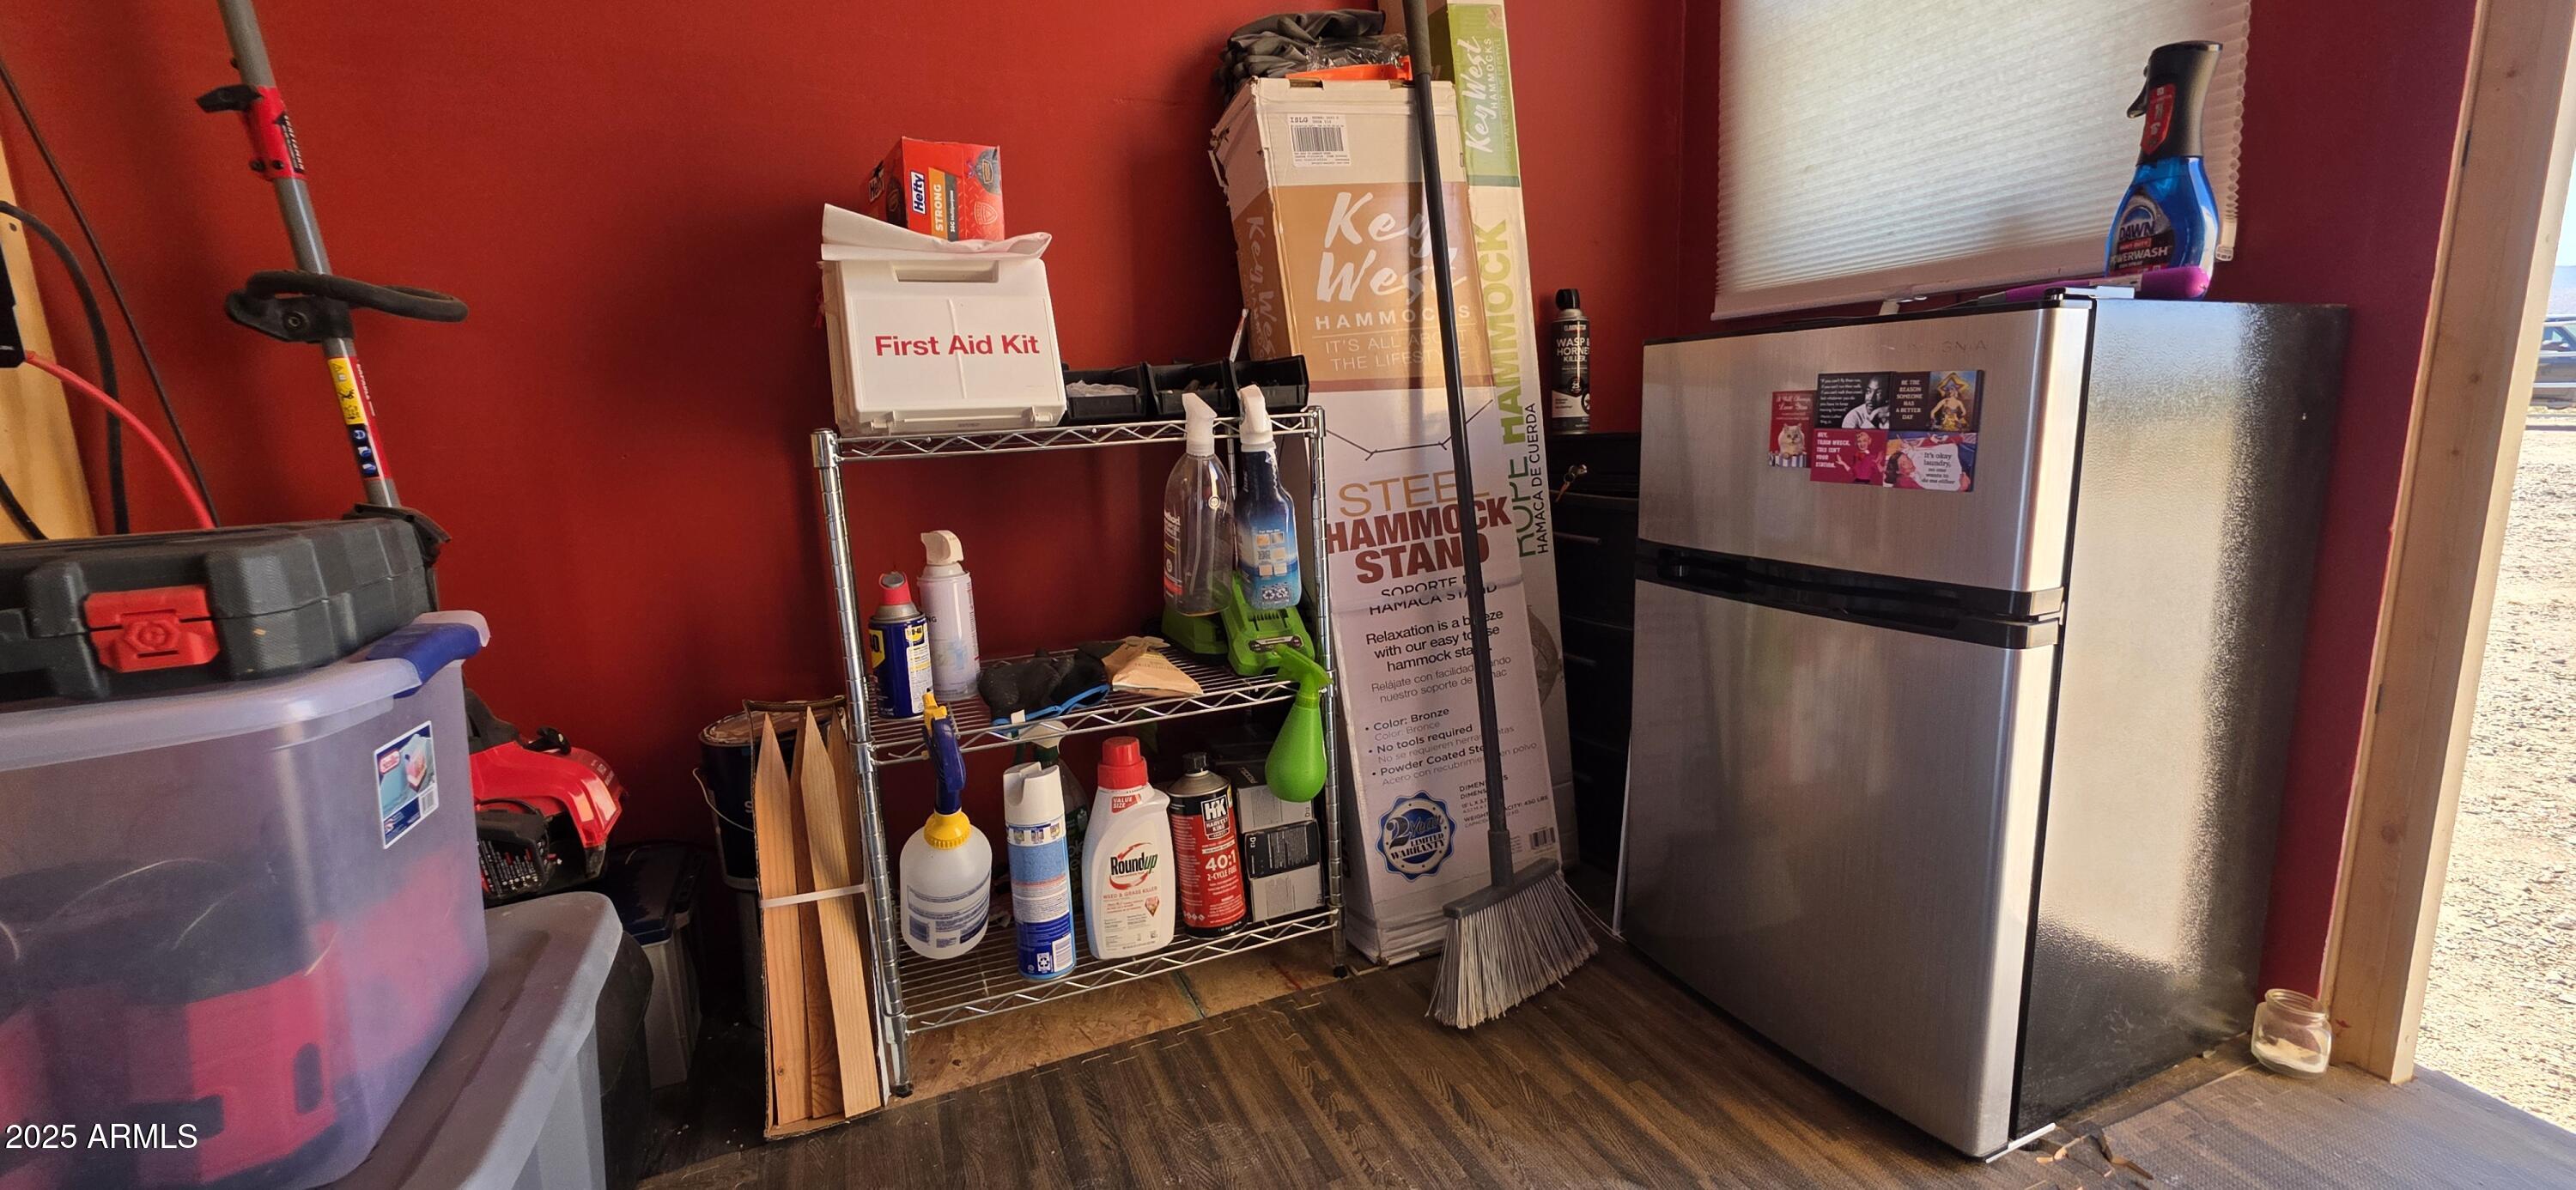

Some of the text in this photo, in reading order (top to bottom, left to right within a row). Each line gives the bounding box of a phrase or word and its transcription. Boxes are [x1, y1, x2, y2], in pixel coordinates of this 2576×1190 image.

[1484, 37, 1499, 110] HAMMOCKS
[1456, 35, 1498, 153] Key West
[913, 173, 926, 213] Hefty
[934, 182, 944, 232] STRONG
[1324, 191, 1431, 258] Key
[2119, 221, 2155, 240] DAWN
[1246, 216, 1278, 361] Key Wes
[1315, 305, 1471, 331] HAMMOCS
[1325, 329, 1467, 354] IT'S ALL ABOT
[1477, 219, 1527, 445] HAMMOCK
[1556, 337, 1585, 348] WASP
[875, 334, 1040, 356] First Aid Kit
[1556, 347, 1589, 356] HORNE
[1330, 347, 1467, 372] THE LIFESTE
[1923, 459, 1952, 468] laundry,
[1935, 452, 1953, 461] okay
[1525, 403, 1549, 554] HAMACA DE CUERDA
[1327, 496, 1512, 554] HAMMOCK
[1355, 532, 1490, 584] STAND
[1381, 576, 1457, 597] SOPORTE
[1370, 585, 1498, 616] HAMACA STD
[1366, 610, 1504, 645] Relaxation is a beze
[1374, 644, 1402, 659] with
[1406, 641, 1427, 653] our
[1431, 634, 1459, 649] easy
[1462, 630, 1473, 641] to
[1388, 645, 1492, 672] hammock sta.
[1371, 677, 1412, 693] Relájate
[1413, 673, 1433, 683] con
[1435, 664, 1474, 679] facilidad
[1380, 675, 1473, 703] nuestro soporte de
[1374, 707, 1449, 732] Color: Bronze
[1375, 721, 1441, 742] Color: Bronce
[1377, 724, 1473, 754] No tools required
[1378, 726, 1516, 765] No se requieren herratas
[1380, 744, 1485, 775] Powder Coated Ste
[1382, 774, 1411, 786] Acero
[1413, 768, 1431, 780] con
[1433, 757, 1485, 775] recubrimie
[1513, 741, 1538, 755] polvo
[1459, 774, 1510, 792] DIMENS
[1205, 798, 1227, 820] HK
[1464, 811, 1489, 823] WEIGHT
[1206, 817, 1229, 829] HARVEST
[1212, 823, 1225, 833] KING
[1386, 813, 1445, 849] 2 Year
[1390, 840, 1446, 861] WARRANTY
[1410, 832, 1445, 848] LIMITED
[1110, 852, 1158, 876] Roundup
[1205, 849, 1236, 871] 40:1
[1207, 865, 1237, 882] 2-CYCLE FUEL
[1124, 889, 1142, 897] GRASS
